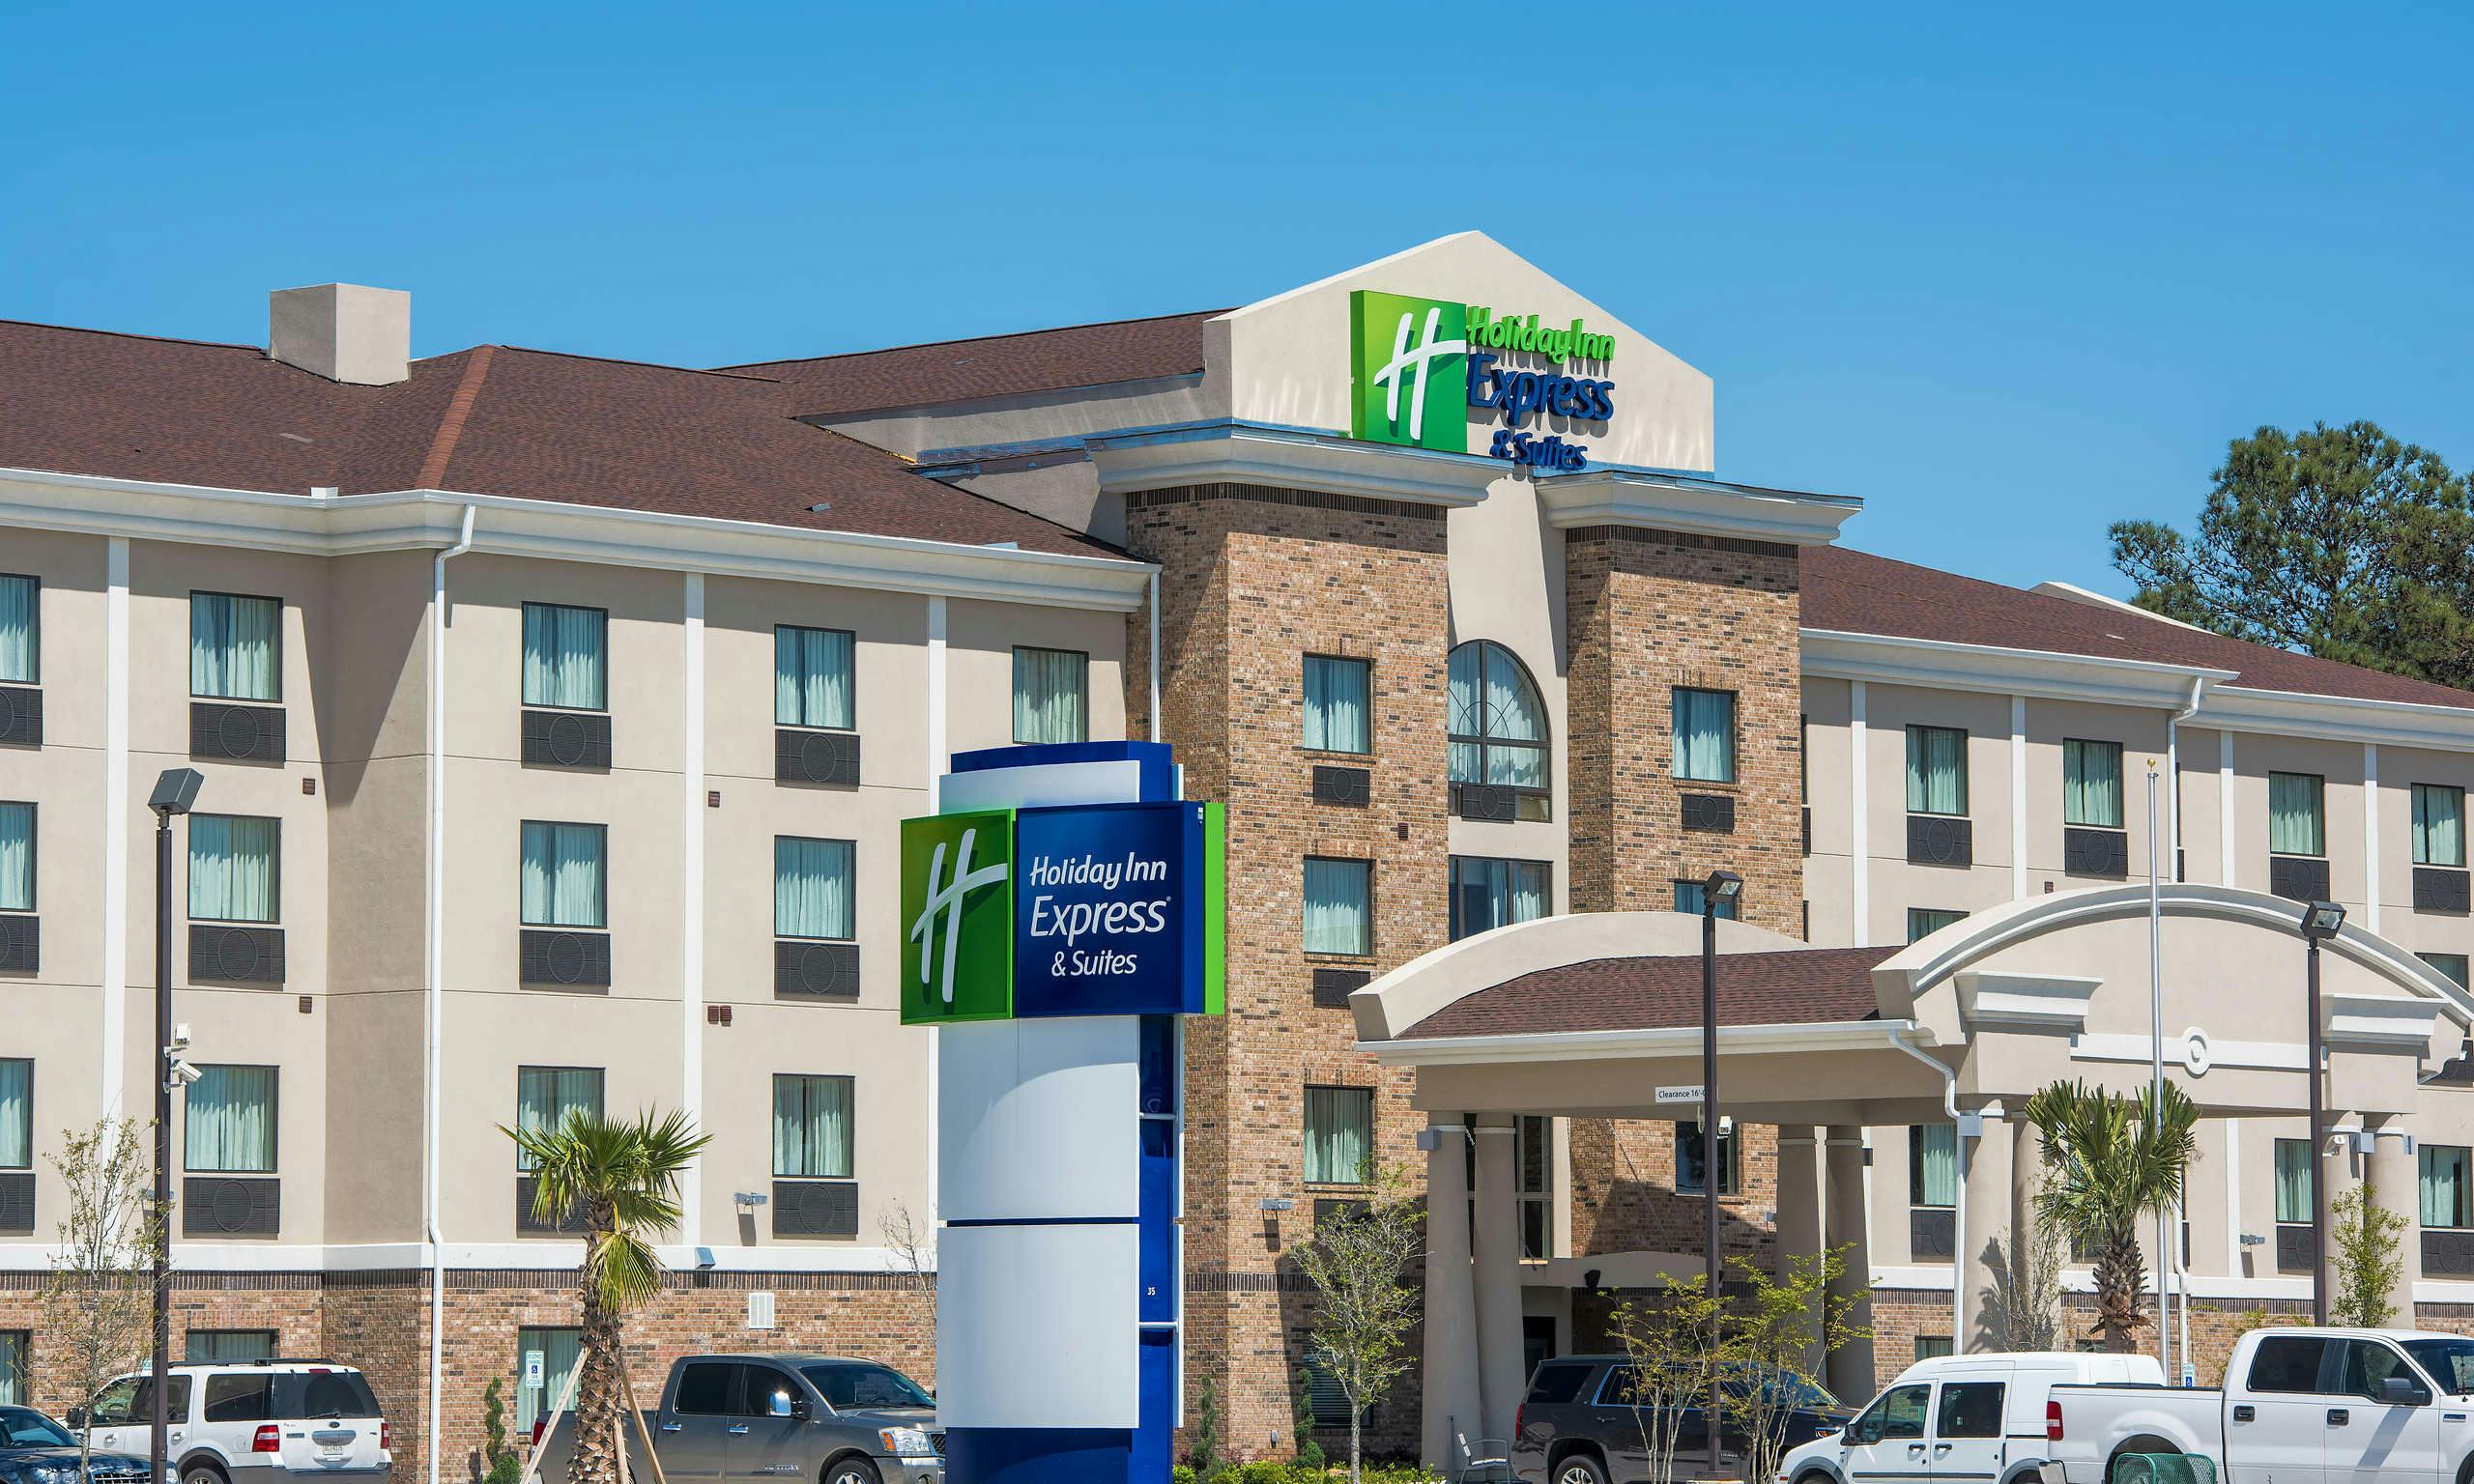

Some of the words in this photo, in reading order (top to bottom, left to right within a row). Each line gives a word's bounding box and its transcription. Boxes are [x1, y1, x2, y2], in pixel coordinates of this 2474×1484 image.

[1467, 353, 1616, 426] Express
[1489, 429, 1512, 460] &
[1513, 432, 1589, 471] Suites
[1029, 854, 1122, 890] Holiday
[1124, 851, 1167, 882] Inn
[1030, 895, 1167, 947] Express
[1050, 951, 1066, 978] &
[1070, 950, 1137, 976] Suites
[1658, 1090, 1690, 1099] Clearance
